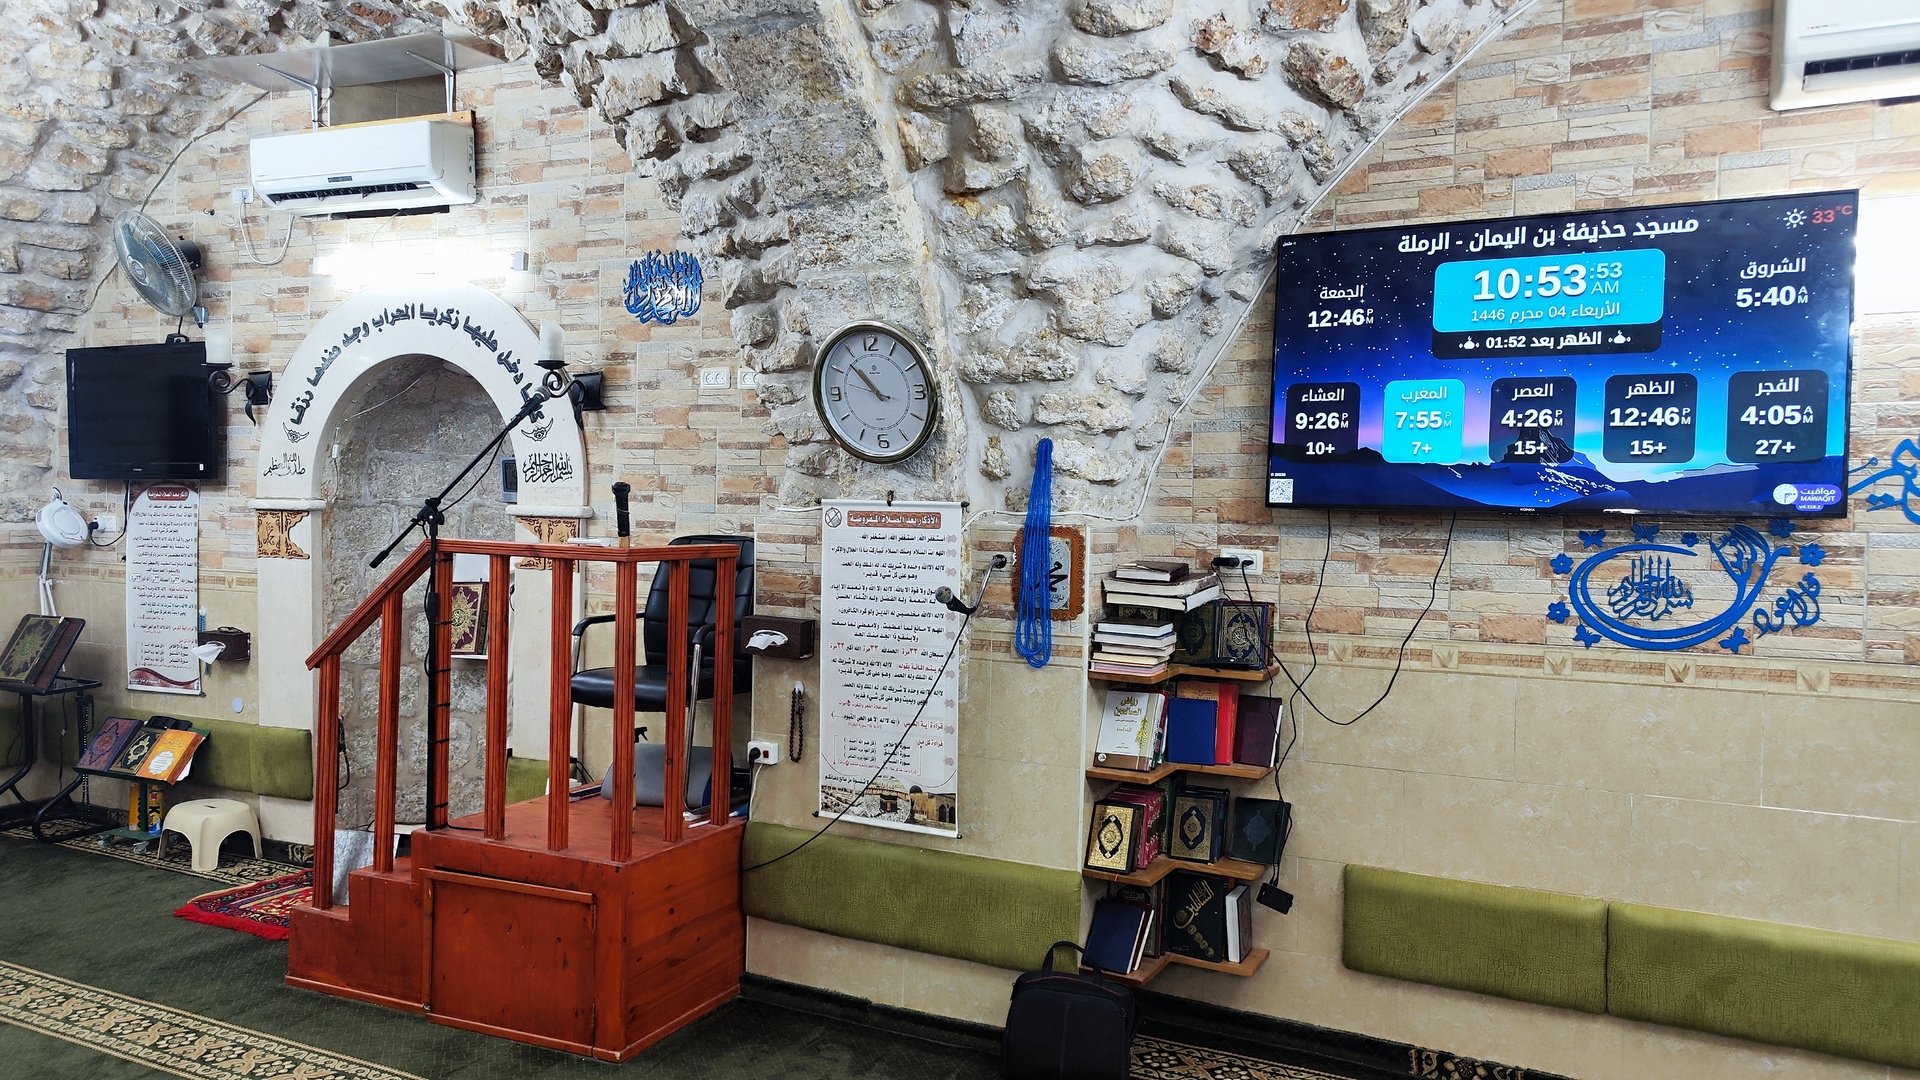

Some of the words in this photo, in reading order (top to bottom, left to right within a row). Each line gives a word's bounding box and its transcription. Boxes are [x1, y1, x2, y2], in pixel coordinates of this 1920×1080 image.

[1532, 226, 1556, 247] بن
[1561, 220, 1627, 243] حذيفة
[1632, 217, 1699, 239] مسجد
[1397, 232, 1450, 256] الرملة
[1467, 226, 1527, 253] اليمان
[1739, 257, 1806, 280] الشروق
[1473, 264, 1587, 301] 10:53
[1590, 281, 1619, 295] AM
[1319, 284, 1364, 301] الجمعة
[1735, 285, 1796, 308] 5:40
[371, 303, 416, 333] المحراب
[419, 303, 461, 331] زكريا
[1307, 308, 1365, 328] 12:46
[1471, 308, 1506, 322] 1446
[1509, 308, 1544, 324] محرم
[1549, 304, 1567, 318] 04
[1571, 302, 1620, 319] الأربعاء
[342, 321, 371, 348] وجد
[463, 315, 499, 352] عليها
[1485, 335, 1526, 350] 01:52
[1530, 333, 1556, 350] بعد
[1562, 331, 1602, 348] الظهر
[863, 334, 879, 352] 12
[829, 386, 842, 401] 9
[912, 384, 927, 400] 3
[1301, 387, 1345, 403] العشاء
[1400, 385, 1448, 403] المغرب
[1511, 383, 1554, 402] العصر
[1624, 380, 1675, 400] الظهر
[1754, 376, 1800, 397] الفجر
[1295, 411, 1340, 430] 9:26
[1395, 410, 1443, 430] 7:55
[1500, 408, 1553, 428] 4:26
[1609, 407, 1680, 427] 12:46
[1740, 404, 1802, 426] 4:05
[877, 433, 890, 449] 6
[1800, 487, 1836, 497] مواقيت
[1800, 495, 1836, 503] MAWAQIT
[850, 514, 880, 525] المفروضة
[882, 514, 904, 524] الصلاة
[906, 515, 916, 526] بعد
[919, 515, 938, 526] الأذكار
